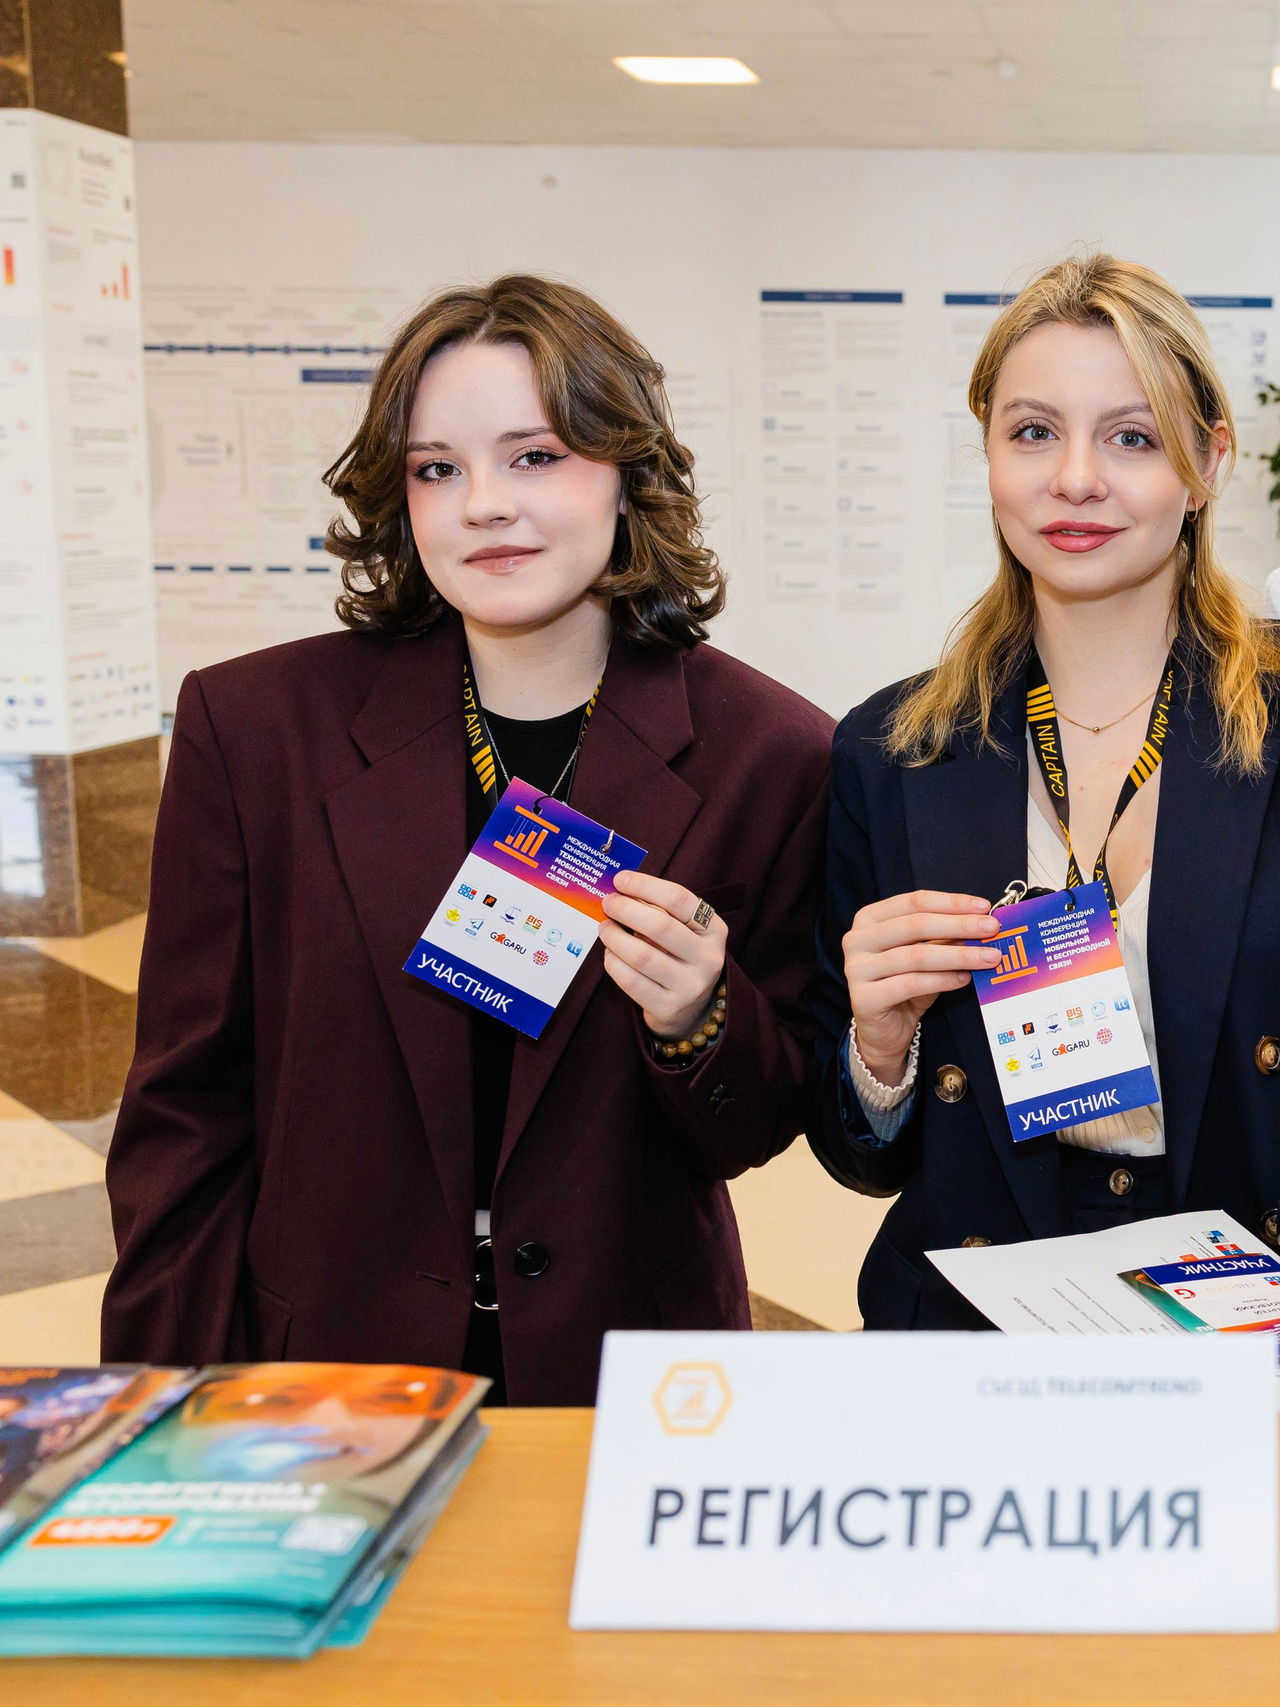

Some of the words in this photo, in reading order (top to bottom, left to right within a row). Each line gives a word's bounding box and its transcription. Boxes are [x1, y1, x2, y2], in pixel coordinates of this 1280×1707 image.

[1036, 724, 1065, 797] CAPTAIN
[563, 842, 607, 871] КОНФЕРЕНЦИЯ
[567, 835, 621, 869] МЕЖДУНАРОДНАЯ
[555, 857, 598, 885] МОБИЛЬНОЙ
[559, 850, 604, 878] ТЕХНОЛОГИИ
[546, 872, 569, 888] СВЯЗИ
[526, 914, 544, 929] BIS
[1038, 907, 1095, 929] МЕЖДУНАРОДНАЯ
[1040, 919, 1087, 937] КОНФЕРЕНЦИЯ
[1042, 927, 1089, 945] ТЕХНОЛОГИИ
[1044, 936, 1090, 953] МОБИЛЬНОЙ
[1053, 938, 1111, 961] БЕСПРОВОДНОЙ
[1048, 959, 1072, 971] СВЯЗИ
[417, 953, 513, 1013] УЧАСТНИК
[1066, 1007, 1083, 1019] BIS
[1018, 1088, 1121, 1131] УЧАСТНИК
[1178, 1258, 1271, 1276] УЧАСТНИК
[646, 1485, 1203, 1557] РЕГИСТРАЦИЯ
